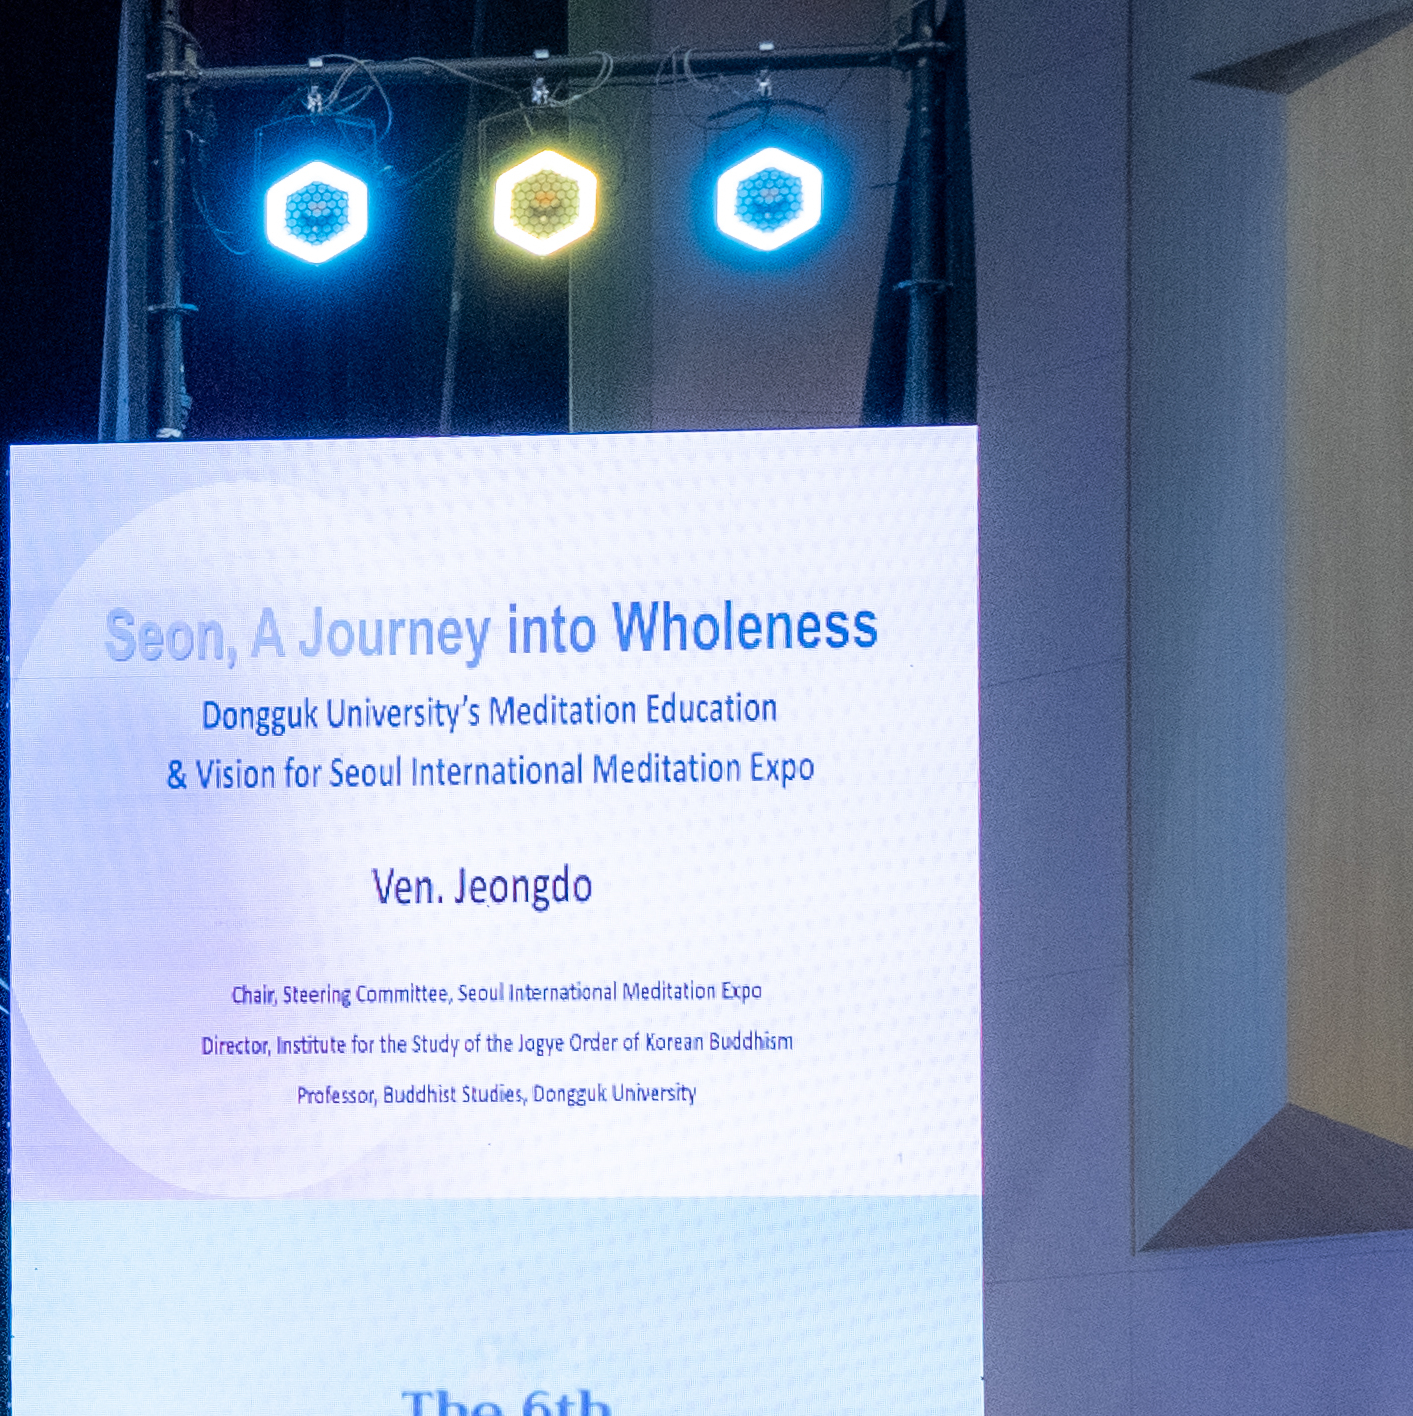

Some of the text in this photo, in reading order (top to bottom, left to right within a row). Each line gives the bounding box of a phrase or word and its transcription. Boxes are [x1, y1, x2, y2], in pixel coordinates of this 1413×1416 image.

[105, 599, 878, 669] Seon, A Journey into Wholeness
[203, 697, 318, 737] Dongguk
[489, 693, 636, 726] Meditation
[647, 691, 777, 724] Education
[167, 751, 815, 790] & Vision for Seoul International Meditation Expo
[372, 863, 593, 911] Ven. Jeongdo
[231, 980, 762, 1008] Chair, Steering Committee, Seoul International Meditation Expo
[201, 1030, 794, 1057] Director, Institute for the Study of the Jogye Order of Korean Buddhism
[298, 1082, 696, 1108] Professor, Buddhist Studies, Dongguk University
